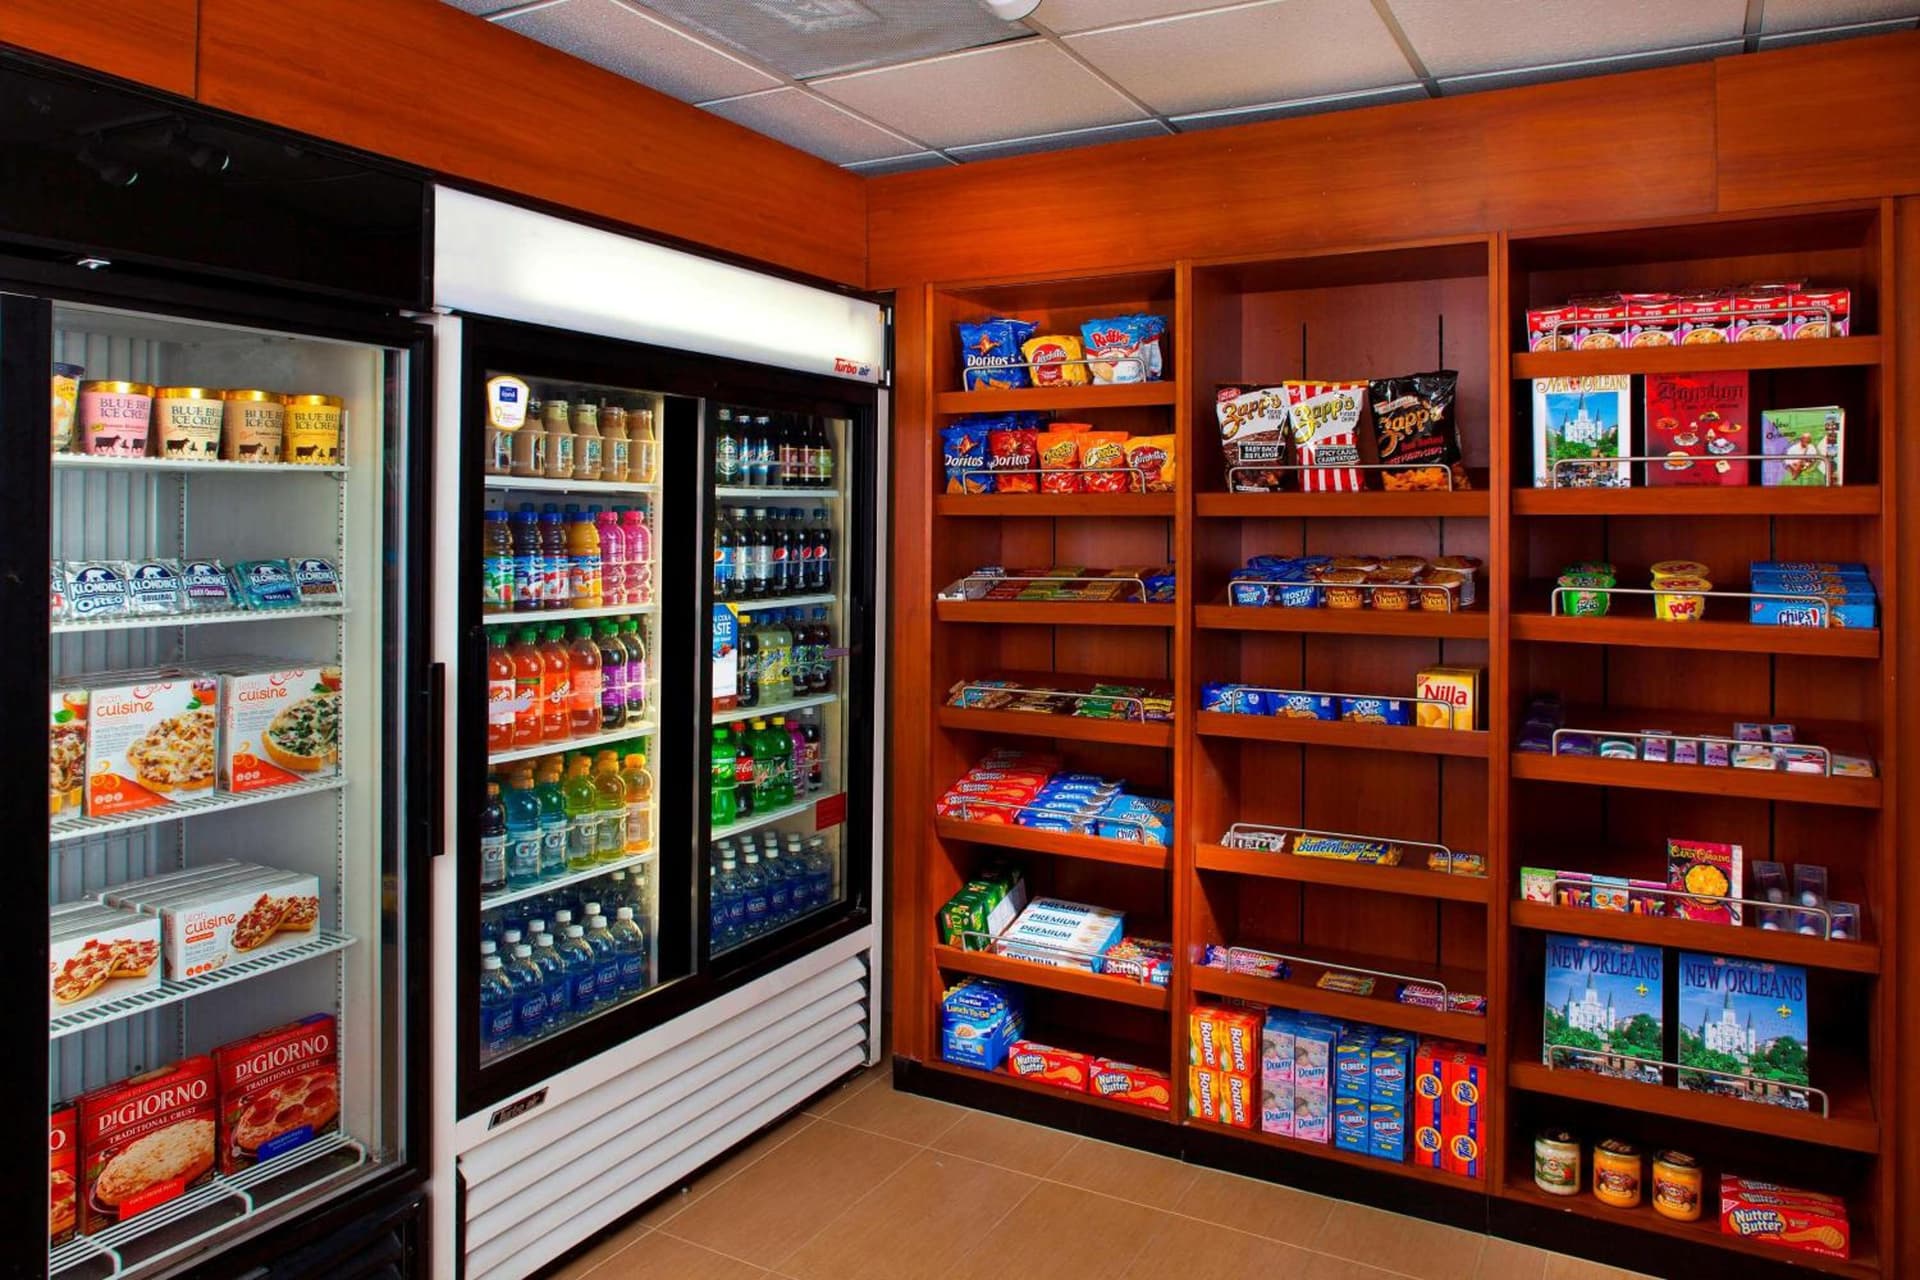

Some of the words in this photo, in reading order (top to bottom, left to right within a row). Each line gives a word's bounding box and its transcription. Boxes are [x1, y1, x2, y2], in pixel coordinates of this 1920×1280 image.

[1092, 329, 1130, 348] Ruffles
[834, 357, 857, 374] Turbo
[858, 365, 871, 376] air
[968, 354, 1009, 367] Doritos
[100, 398, 134, 408] BLUE
[171, 405, 202, 416] BLUE
[101, 408, 121, 418] ICE
[171, 416, 190, 425] ICE
[245, 409, 272, 419] BLUE
[295, 412, 322, 421] BLUE
[1221, 394, 1281, 440] Zapp's
[1295, 396, 1354, 444] Zapp's
[245, 418, 262, 428] ICE
[295, 421, 311, 430] ICE
[1379, 400, 1444, 457] Zapp's
[944, 454, 984, 467] Doritos
[992, 454, 1031, 467] Doritos
[181, 575, 227, 589] KLONDIKE
[251, 574, 290, 586] KLONDIKE
[296, 571, 336, 583] KLONDIKE
[70, 581, 125, 600] KLONDIKE
[128, 579, 178, 597] KLONDIKE
[76, 597, 124, 613] OREO
[1670, 602, 1696, 617] POPS
[239, 687, 287, 702] cuisine
[1424, 684, 1468, 706] Nilla
[96, 700, 154, 717] cuisine
[515, 841, 540, 858] G2
[1039, 900, 1090, 914] PREMIUM
[184, 912, 236, 937] cuisine
[1029, 913, 1081, 928] PREMIUM
[1019, 924, 1071, 940] PREMIUM
[1551, 945, 1584, 971] NEW
[1588, 949, 1660, 981] ORLEANS
[1683, 963, 1721, 990] NEW
[1725, 968, 1803, 1002] ORLEANS
[946, 1004, 968, 1014] Lunch
[1200, 1021, 1216, 1066] Bounce
[1230, 1027, 1246, 1071] Bounce
[236, 1034, 329, 1079] DIGIORNO
[1016, 1055, 1041, 1064] Nutter
[1020, 1062, 1044, 1074] Butter
[1266, 1059, 1292, 1071] Downy
[1298, 1066, 1326, 1078] Downy
[245, 1067, 296, 1092] TRADITIONAL
[297, 1059, 320, 1072] CRUST
[1098, 1073, 1126, 1084] Nutter
[1102, 1082, 1129, 1094] Butter
[1199, 1072, 1213, 1117] Bounce
[99, 1079, 207, 1131] DIGIORNO
[1230, 1078, 1245, 1122] Bounce
[1265, 1110, 1291, 1122] Downy
[1298, 1117, 1325, 1129] Downy
[110, 1116, 168, 1144] TRADITIONAL
[170, 1106, 197, 1120] CRUST
[1734, 1210, 1777, 1223] Nutter
[1740, 1220, 1782, 1235] Butter
